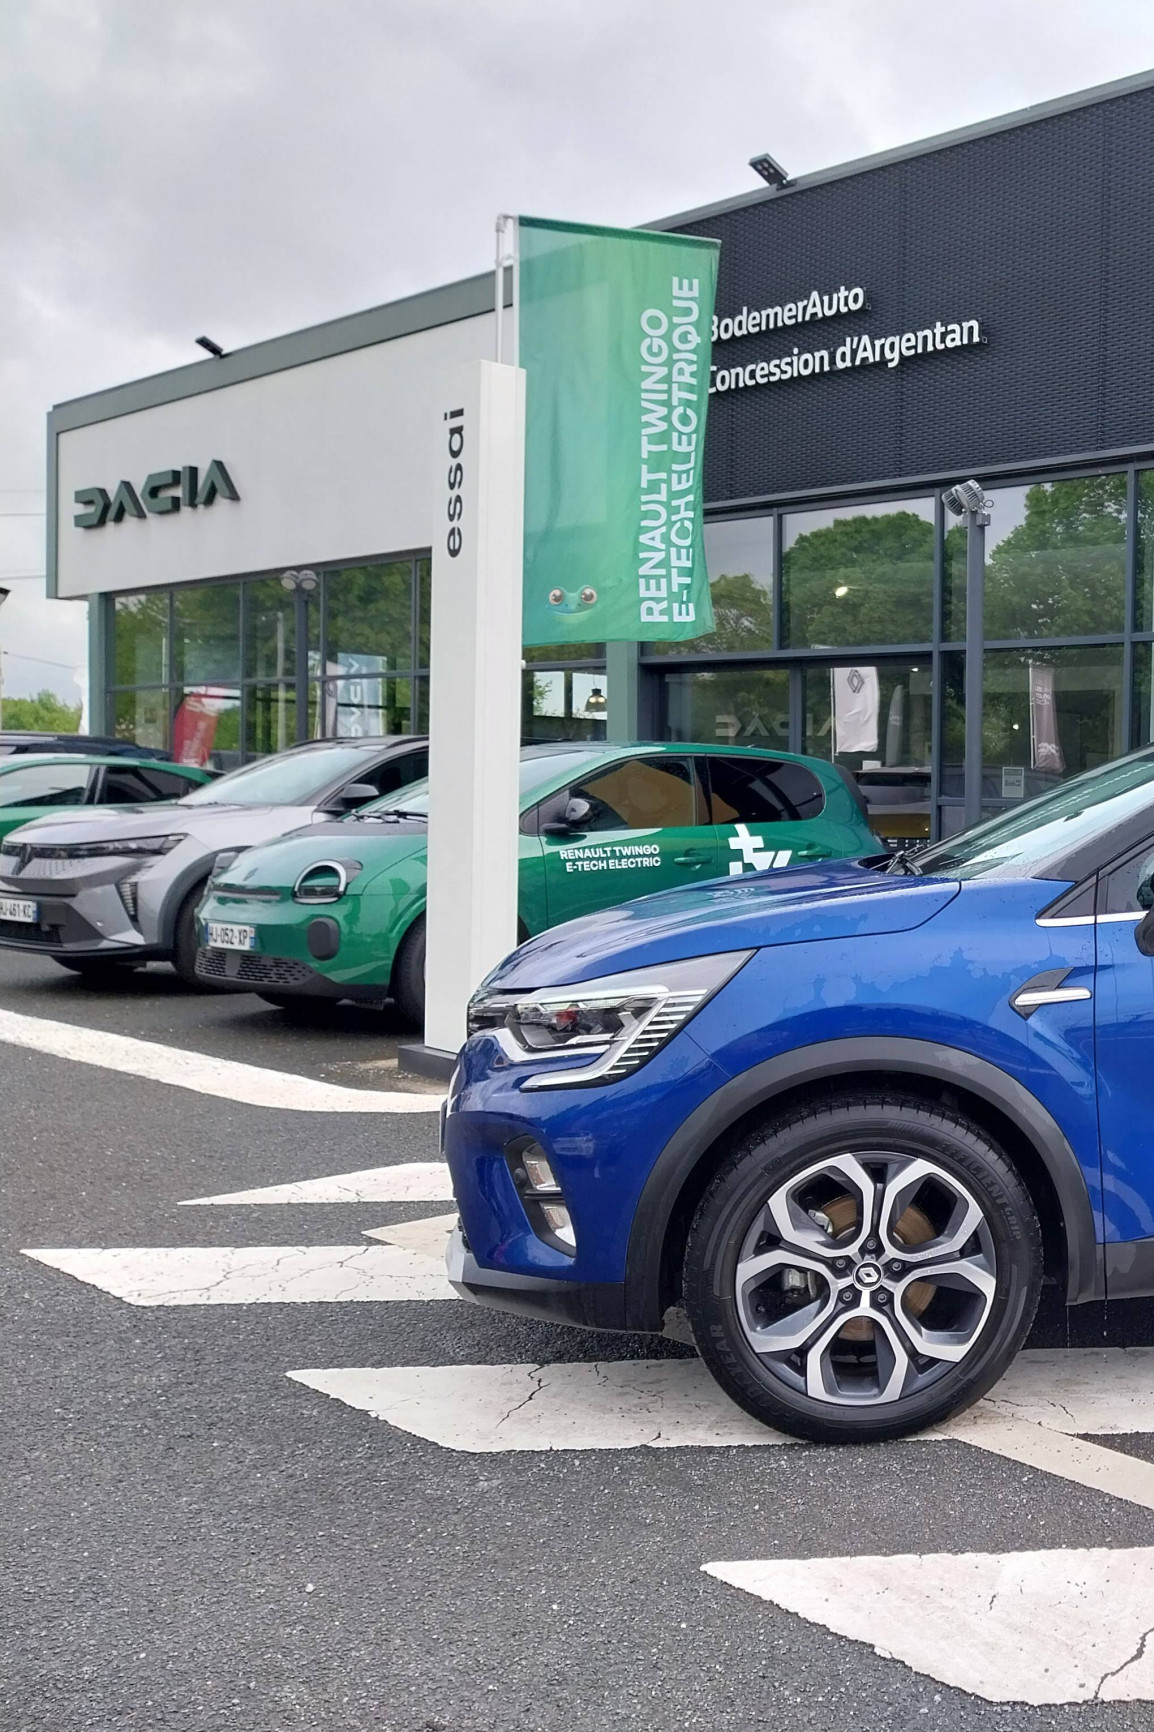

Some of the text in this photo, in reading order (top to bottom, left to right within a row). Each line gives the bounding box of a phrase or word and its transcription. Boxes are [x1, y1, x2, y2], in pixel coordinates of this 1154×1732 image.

[708, 318, 981, 394] Concession d'Argentan
[444, 408, 464, 558] essai
[639, 308, 669, 622] RENAULT TWINGO
[670, 276, 701, 622] E-TECH ELECTRIQUE
[73, 459, 241, 529] DACIA
[560, 844, 660, 860] RENAULT TWINGO
[565, 857, 661, 872] E-TECH ELECTRIC
